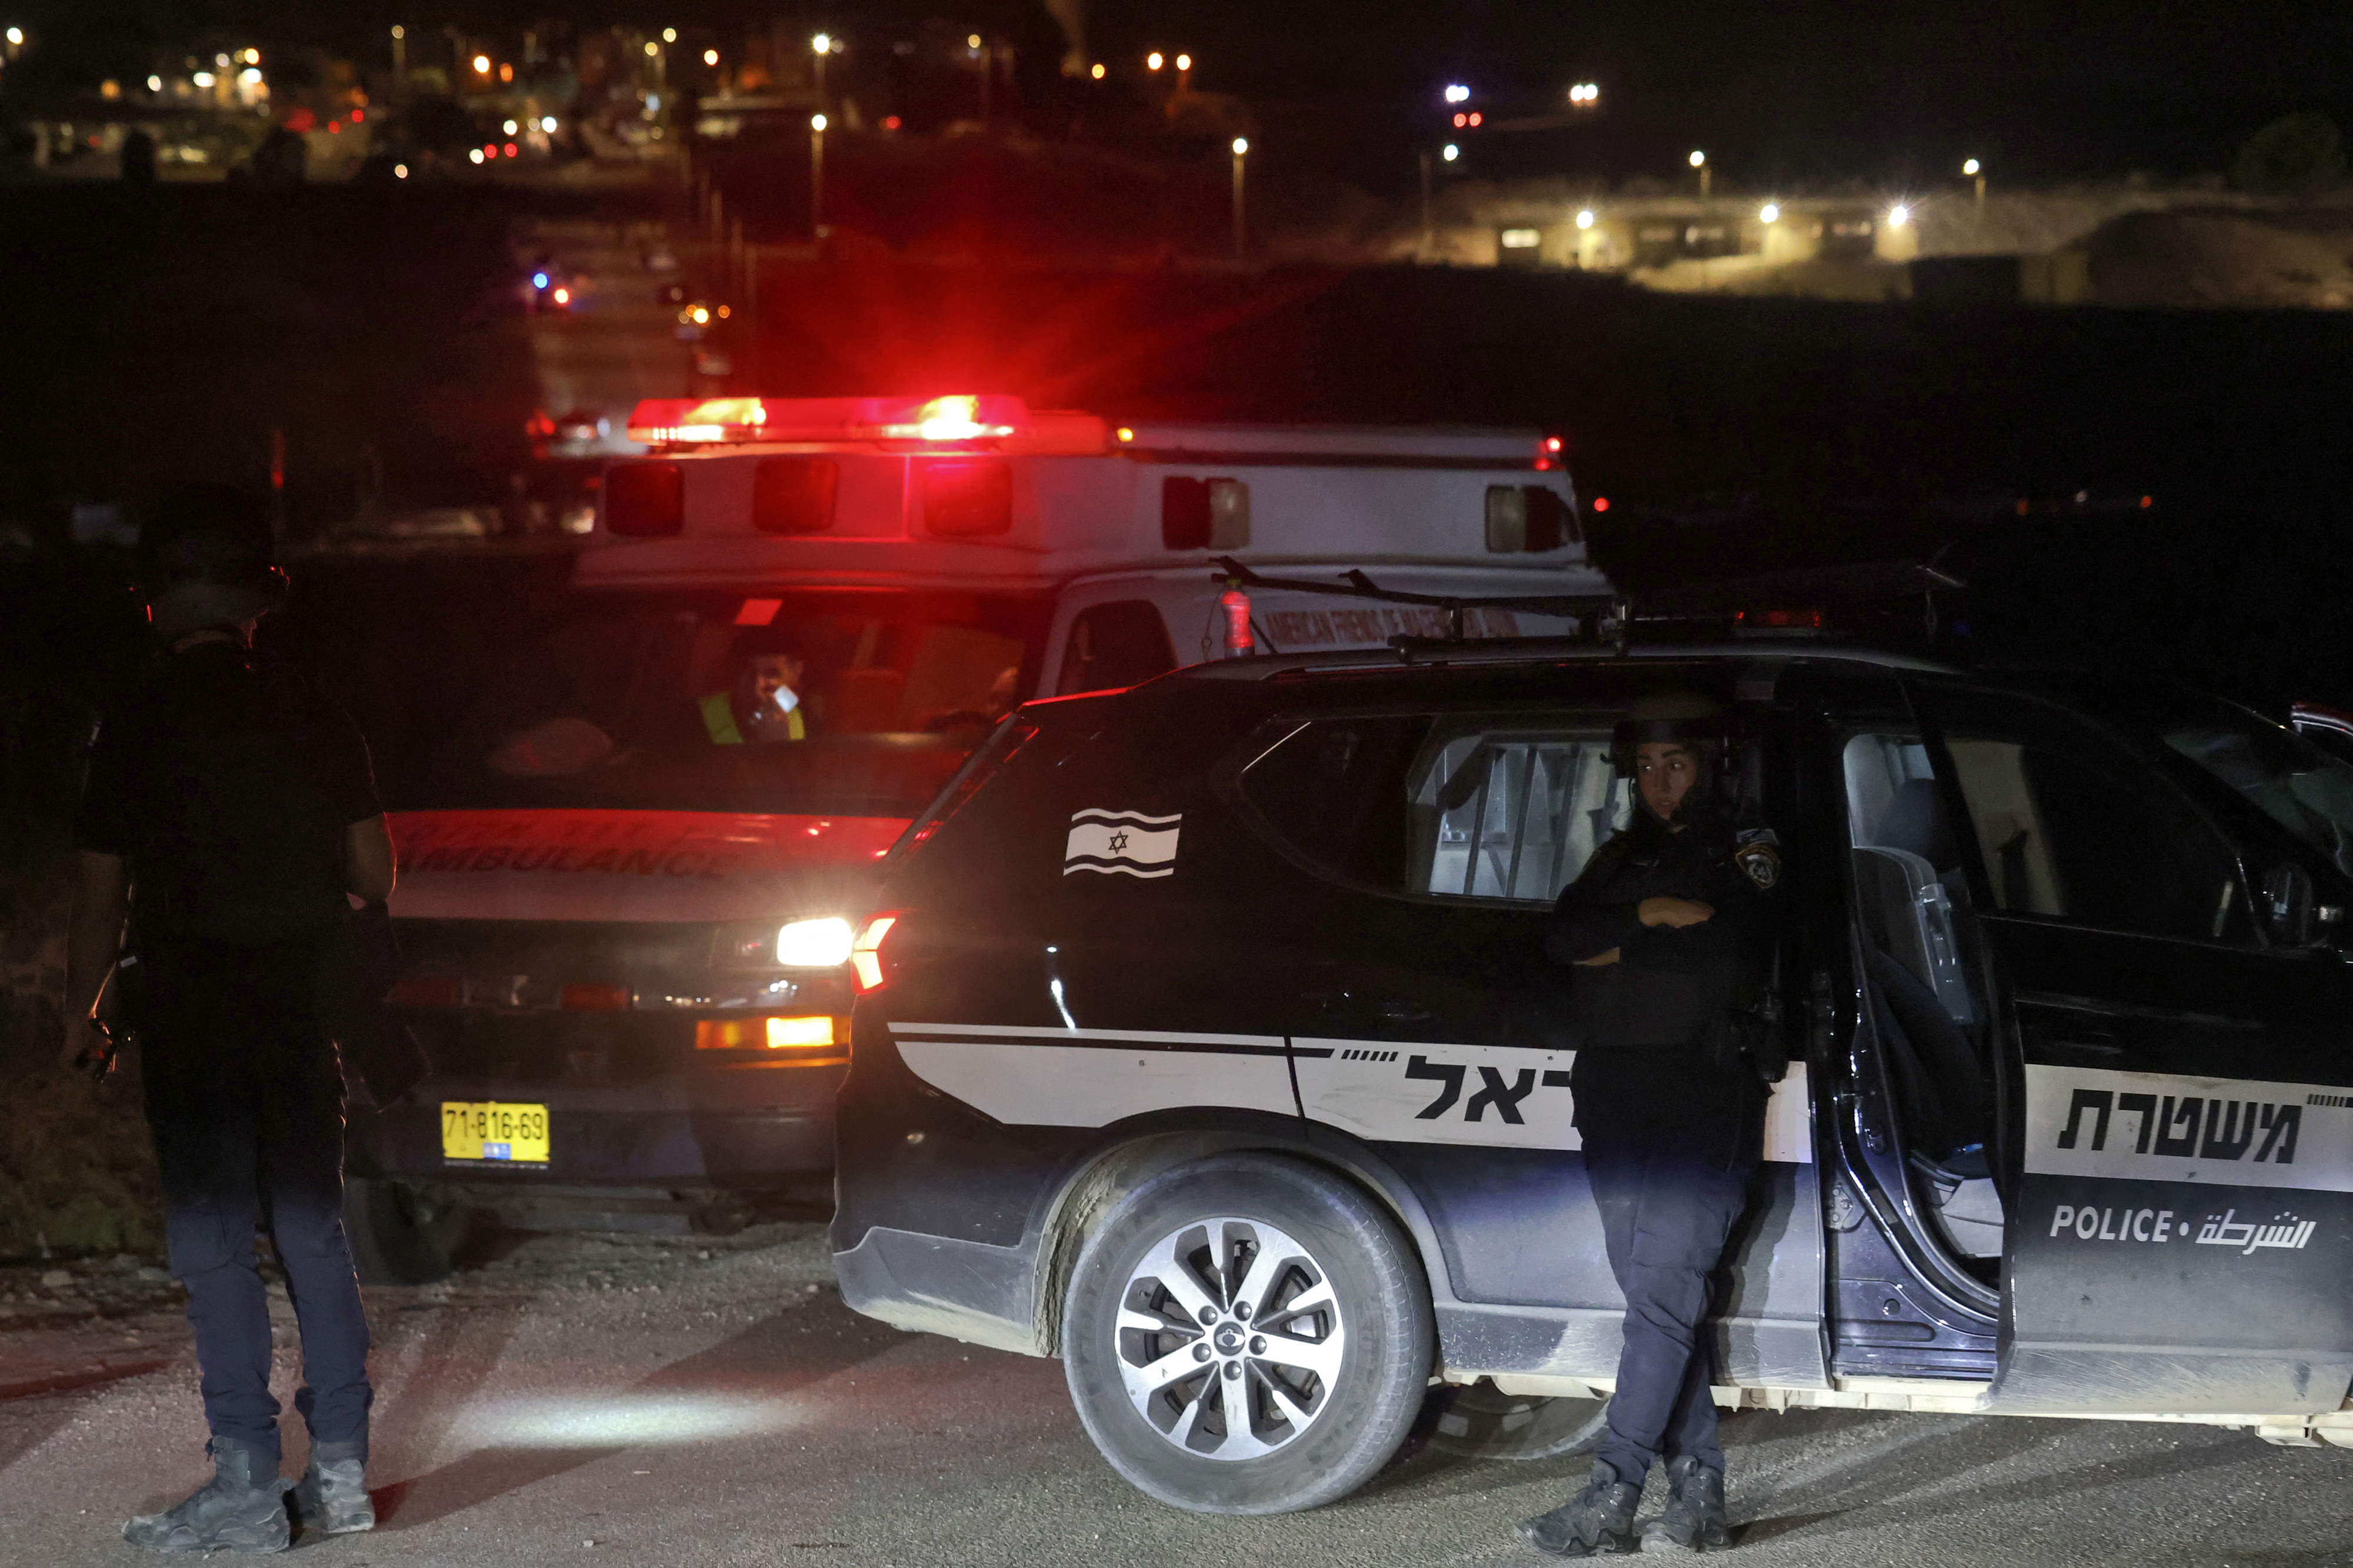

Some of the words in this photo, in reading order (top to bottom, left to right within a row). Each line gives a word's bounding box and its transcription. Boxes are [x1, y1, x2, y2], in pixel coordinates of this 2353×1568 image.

[2057, 1088, 2302, 1164] משטרת
[2049, 1205, 2174, 1243] POLICE
[2195, 1207, 2317, 1255] الشرطة
